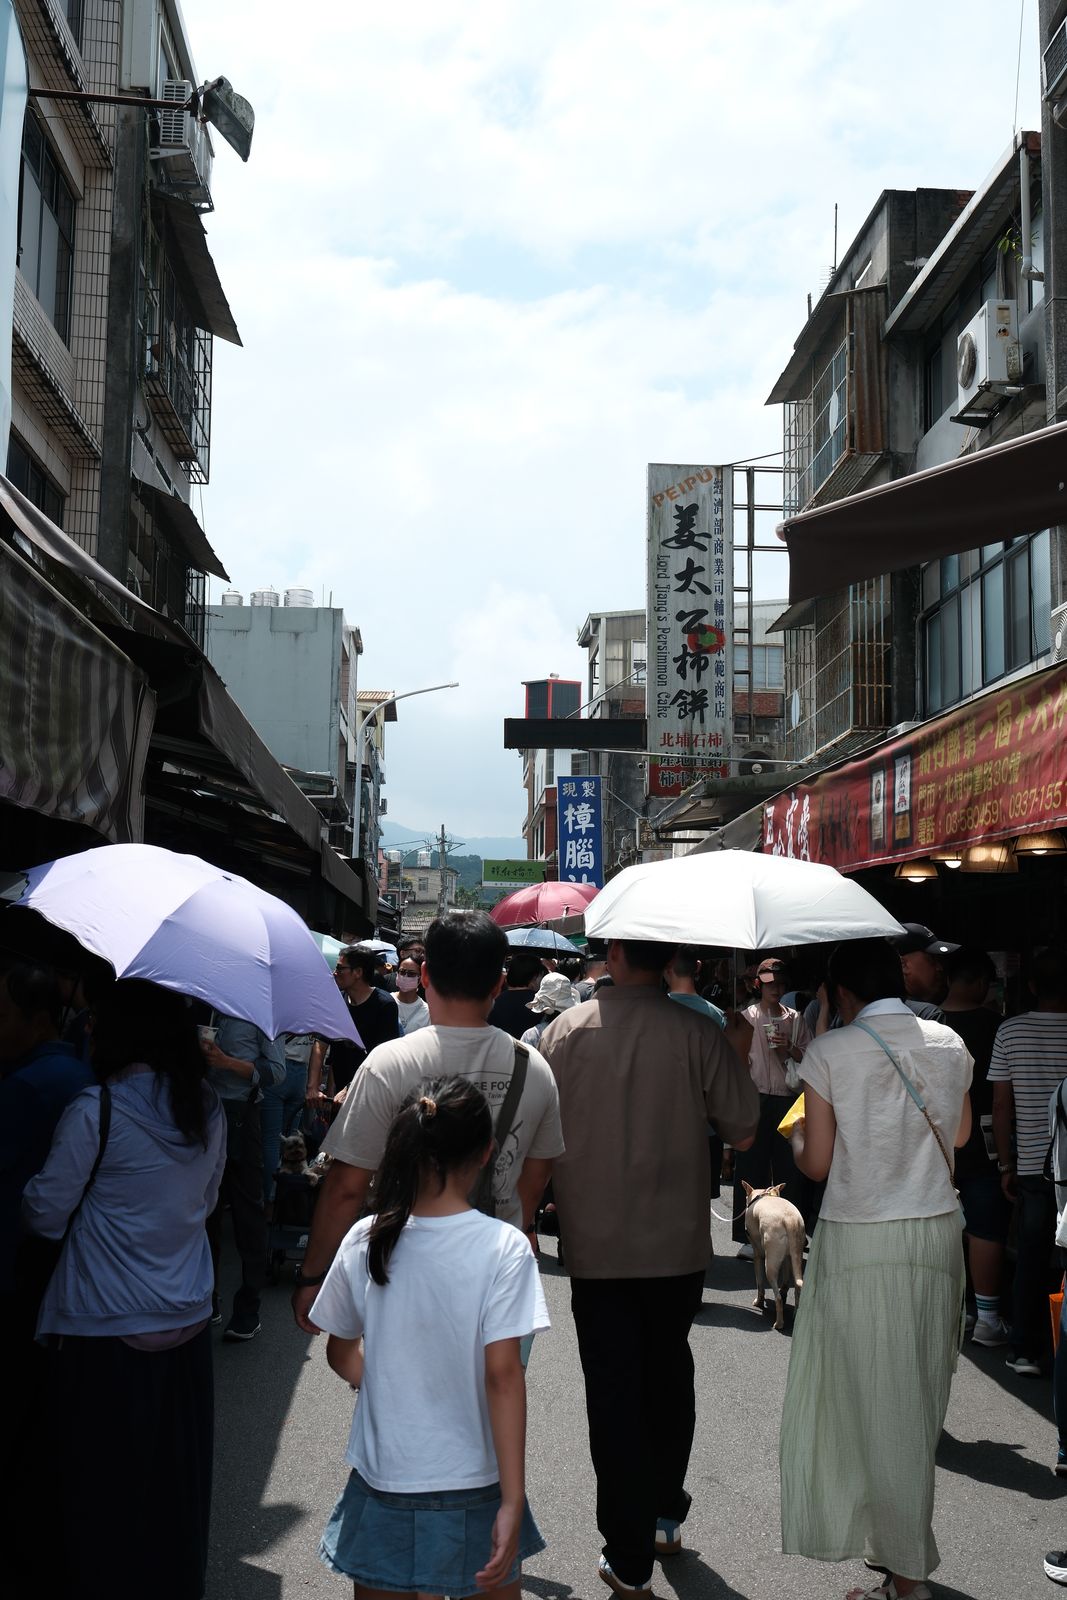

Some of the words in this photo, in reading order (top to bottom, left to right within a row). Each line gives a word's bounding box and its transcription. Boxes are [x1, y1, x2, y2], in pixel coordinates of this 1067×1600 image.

[656, 554, 671, 579] Lord
[655, 584, 671, 622] Jiang's
[661, 503, 712, 723] 姜太公柿餅
[656, 627, 671, 687] Persimmon
[656, 692, 671, 719] Cake
[659, 732, 723, 749] 北埔石柿
[562, 781, 596, 797] 現製
